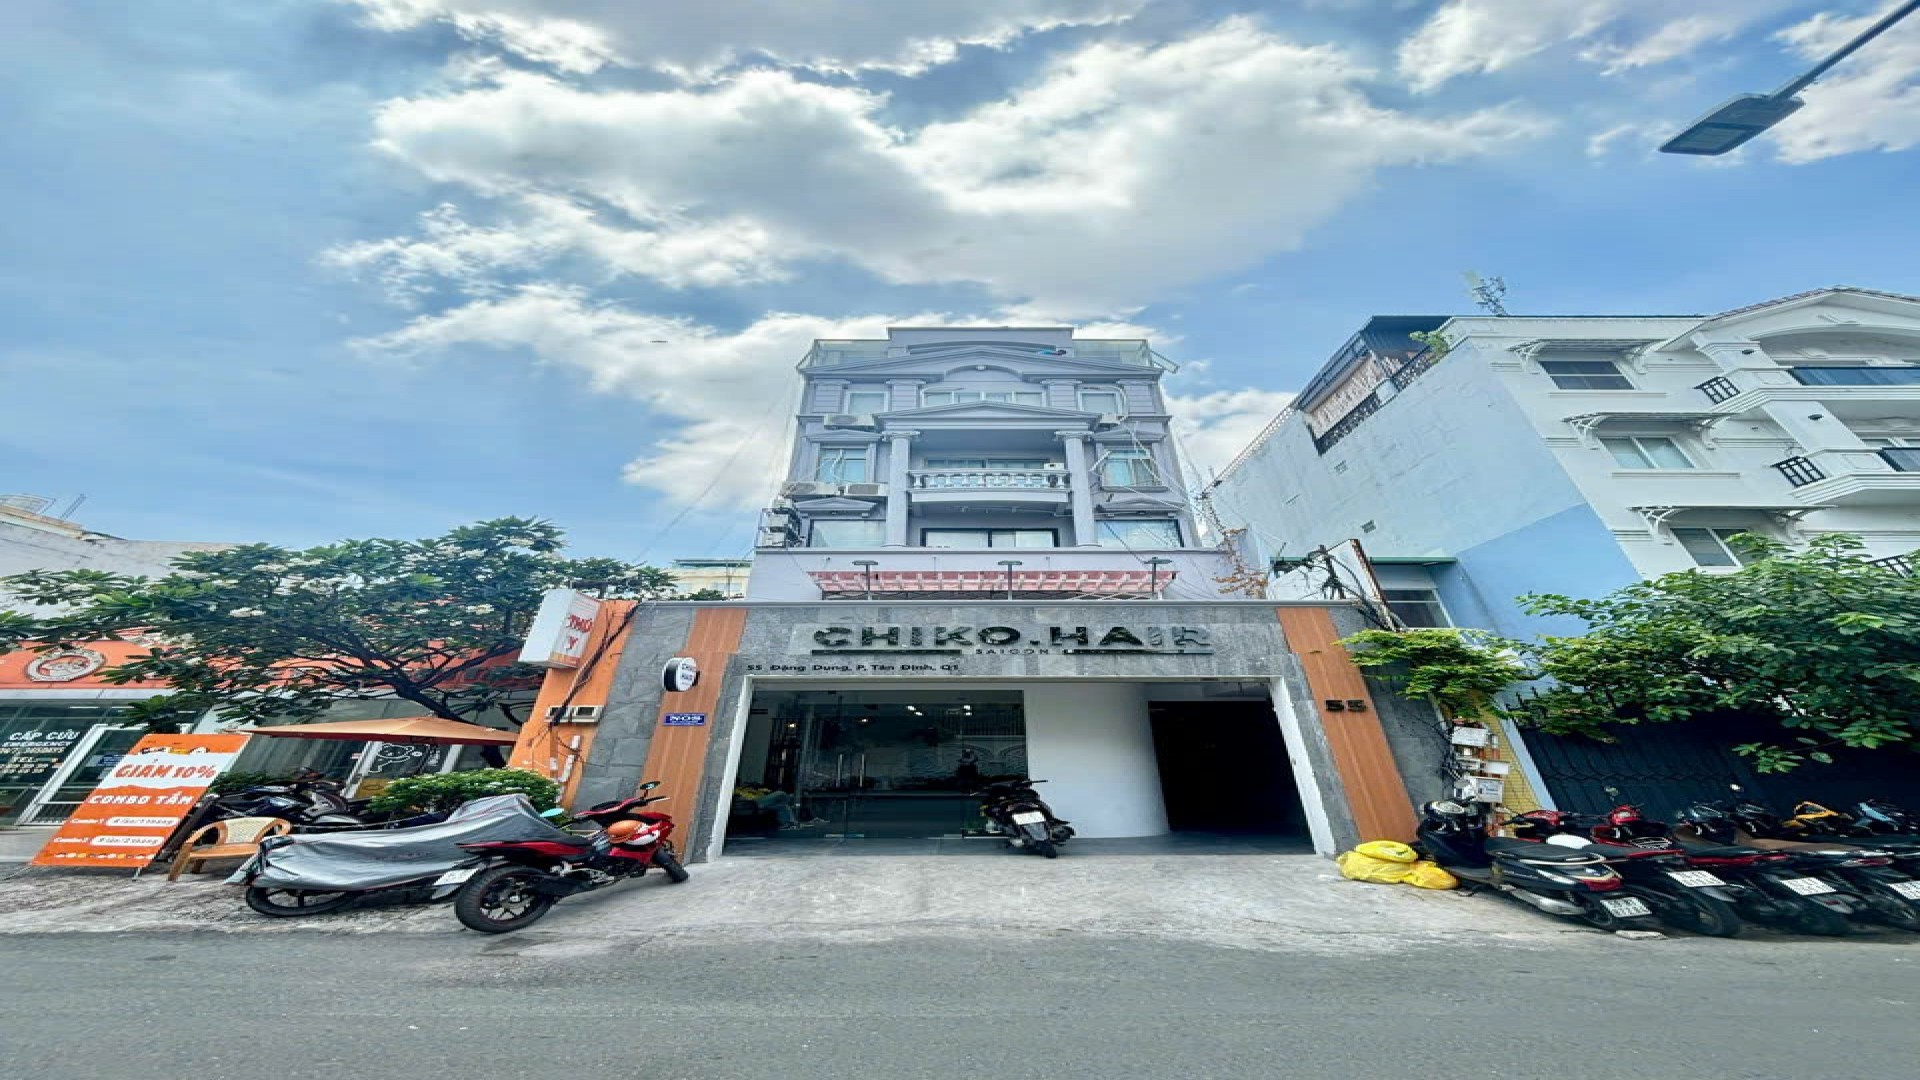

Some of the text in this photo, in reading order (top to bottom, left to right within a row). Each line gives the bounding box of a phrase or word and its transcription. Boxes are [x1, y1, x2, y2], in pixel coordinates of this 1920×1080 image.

[1325, 699, 1368, 712] 55
[172, 764, 217, 778] 10%
[88, 795, 151, 804] COMBO
